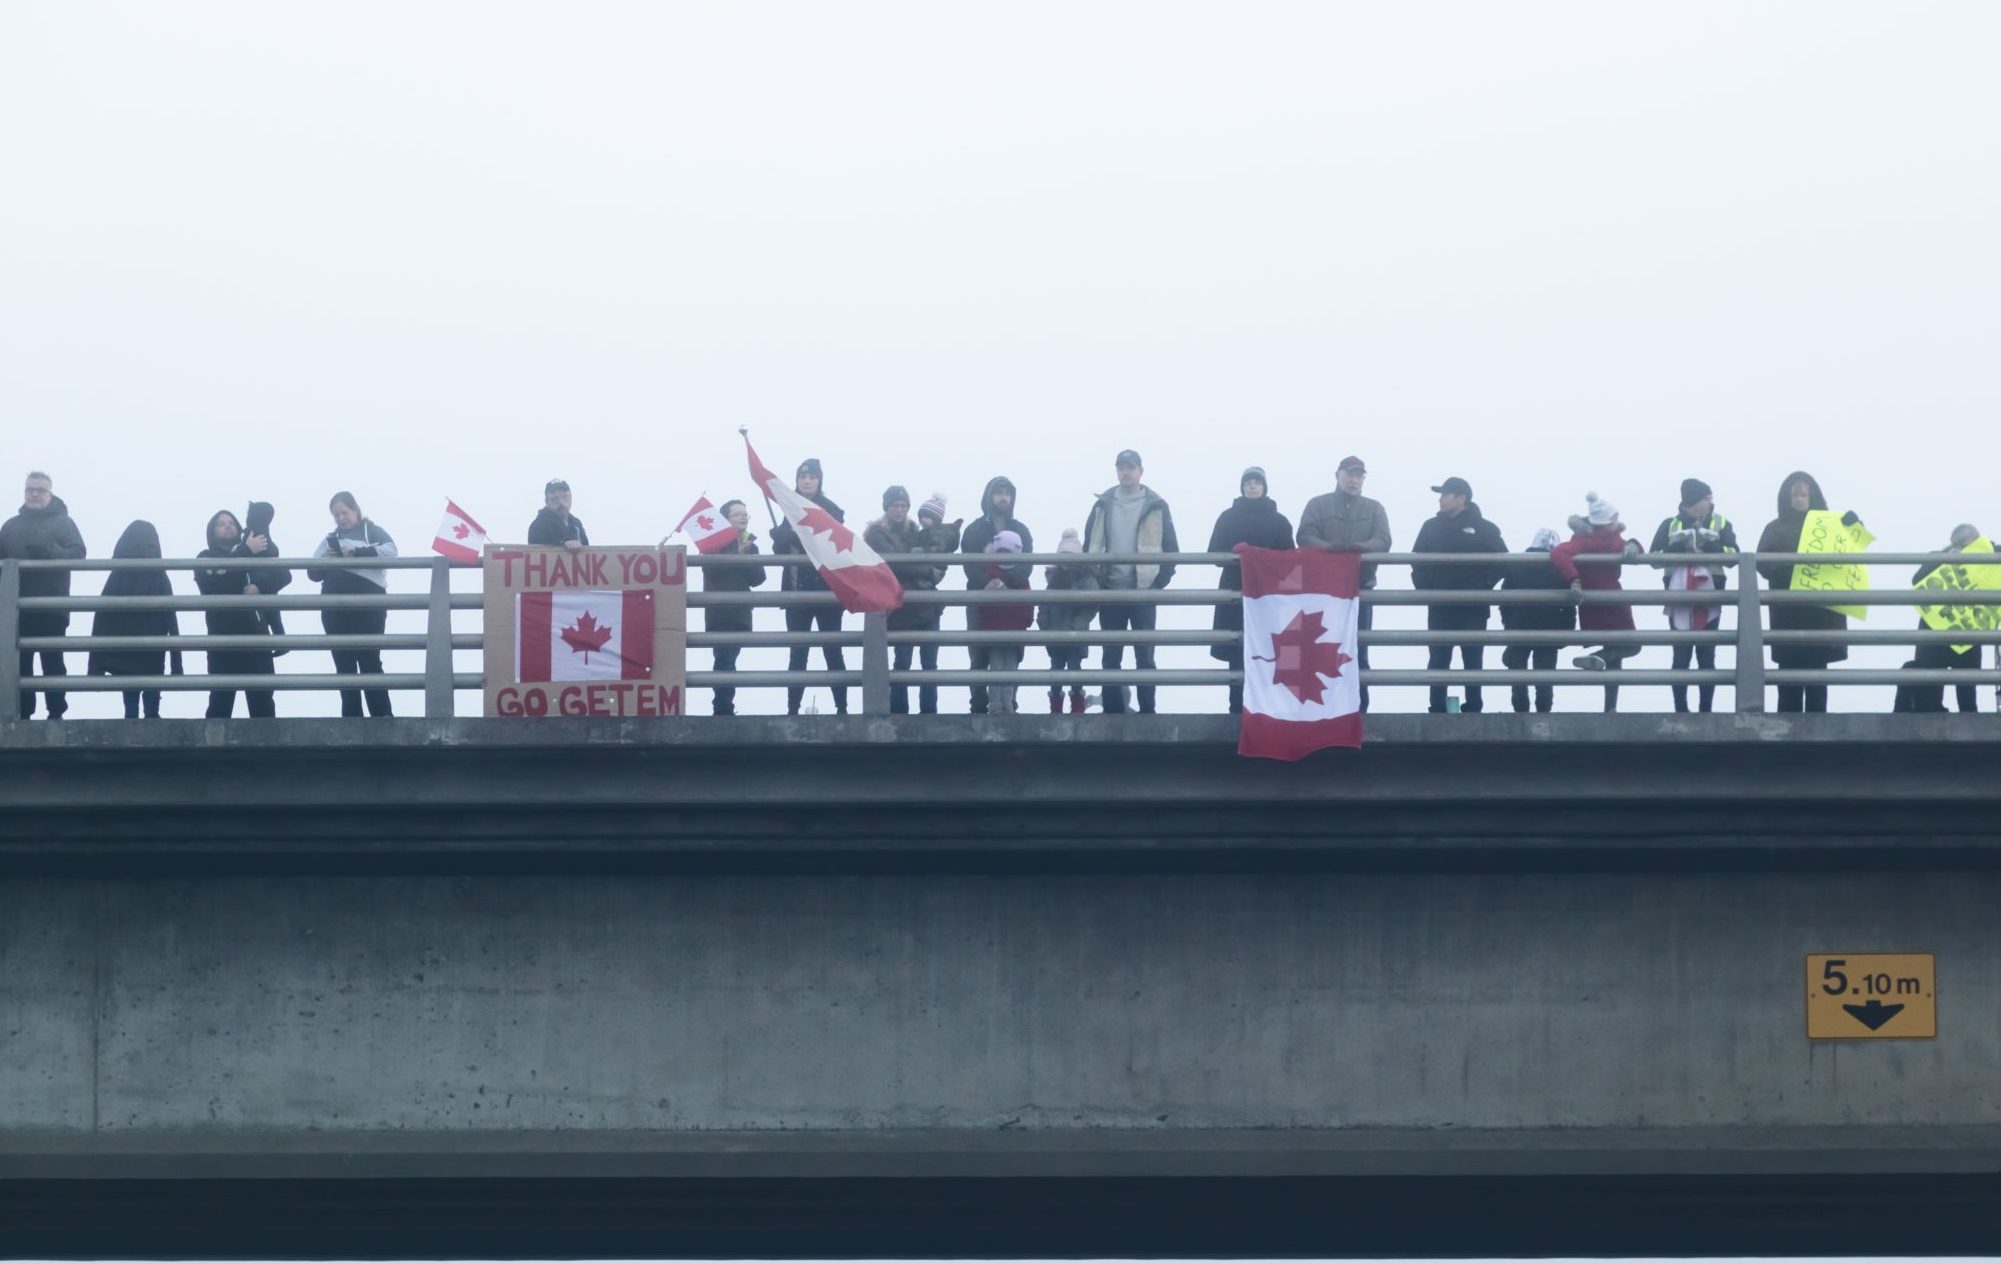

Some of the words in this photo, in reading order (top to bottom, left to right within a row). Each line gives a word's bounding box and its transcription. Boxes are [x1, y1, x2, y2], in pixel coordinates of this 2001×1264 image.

[493, 552, 609, 587] THANK
[617, 551, 685, 586] YOU
[496, 687, 548, 717] GO
